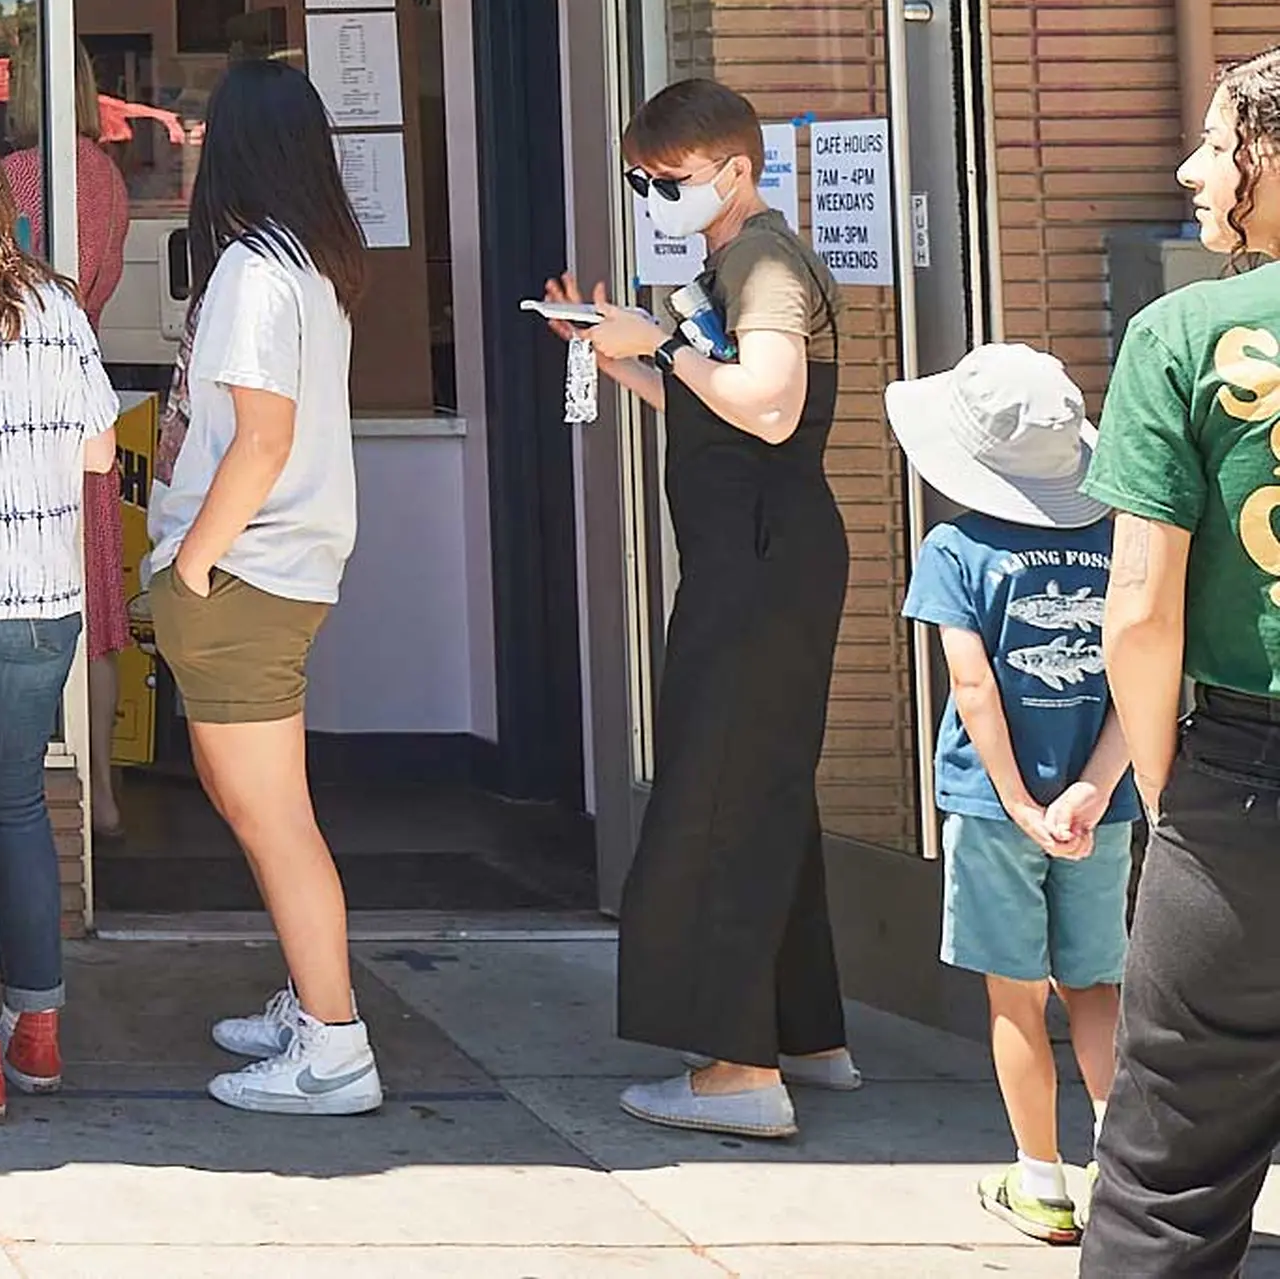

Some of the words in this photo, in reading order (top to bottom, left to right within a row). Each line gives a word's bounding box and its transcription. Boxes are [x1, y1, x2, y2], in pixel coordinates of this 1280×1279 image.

[816, 132, 842, 155] CAFÉ
[844, 134, 884, 154] HOURS
[817, 169, 839, 187] 7AM
[850, 168, 875, 186] 4PM
[816, 193, 875, 211] WEEKDAYS
[817, 225, 869, 244] 7AM-3PM
[914, 198, 926, 263] PUSH
